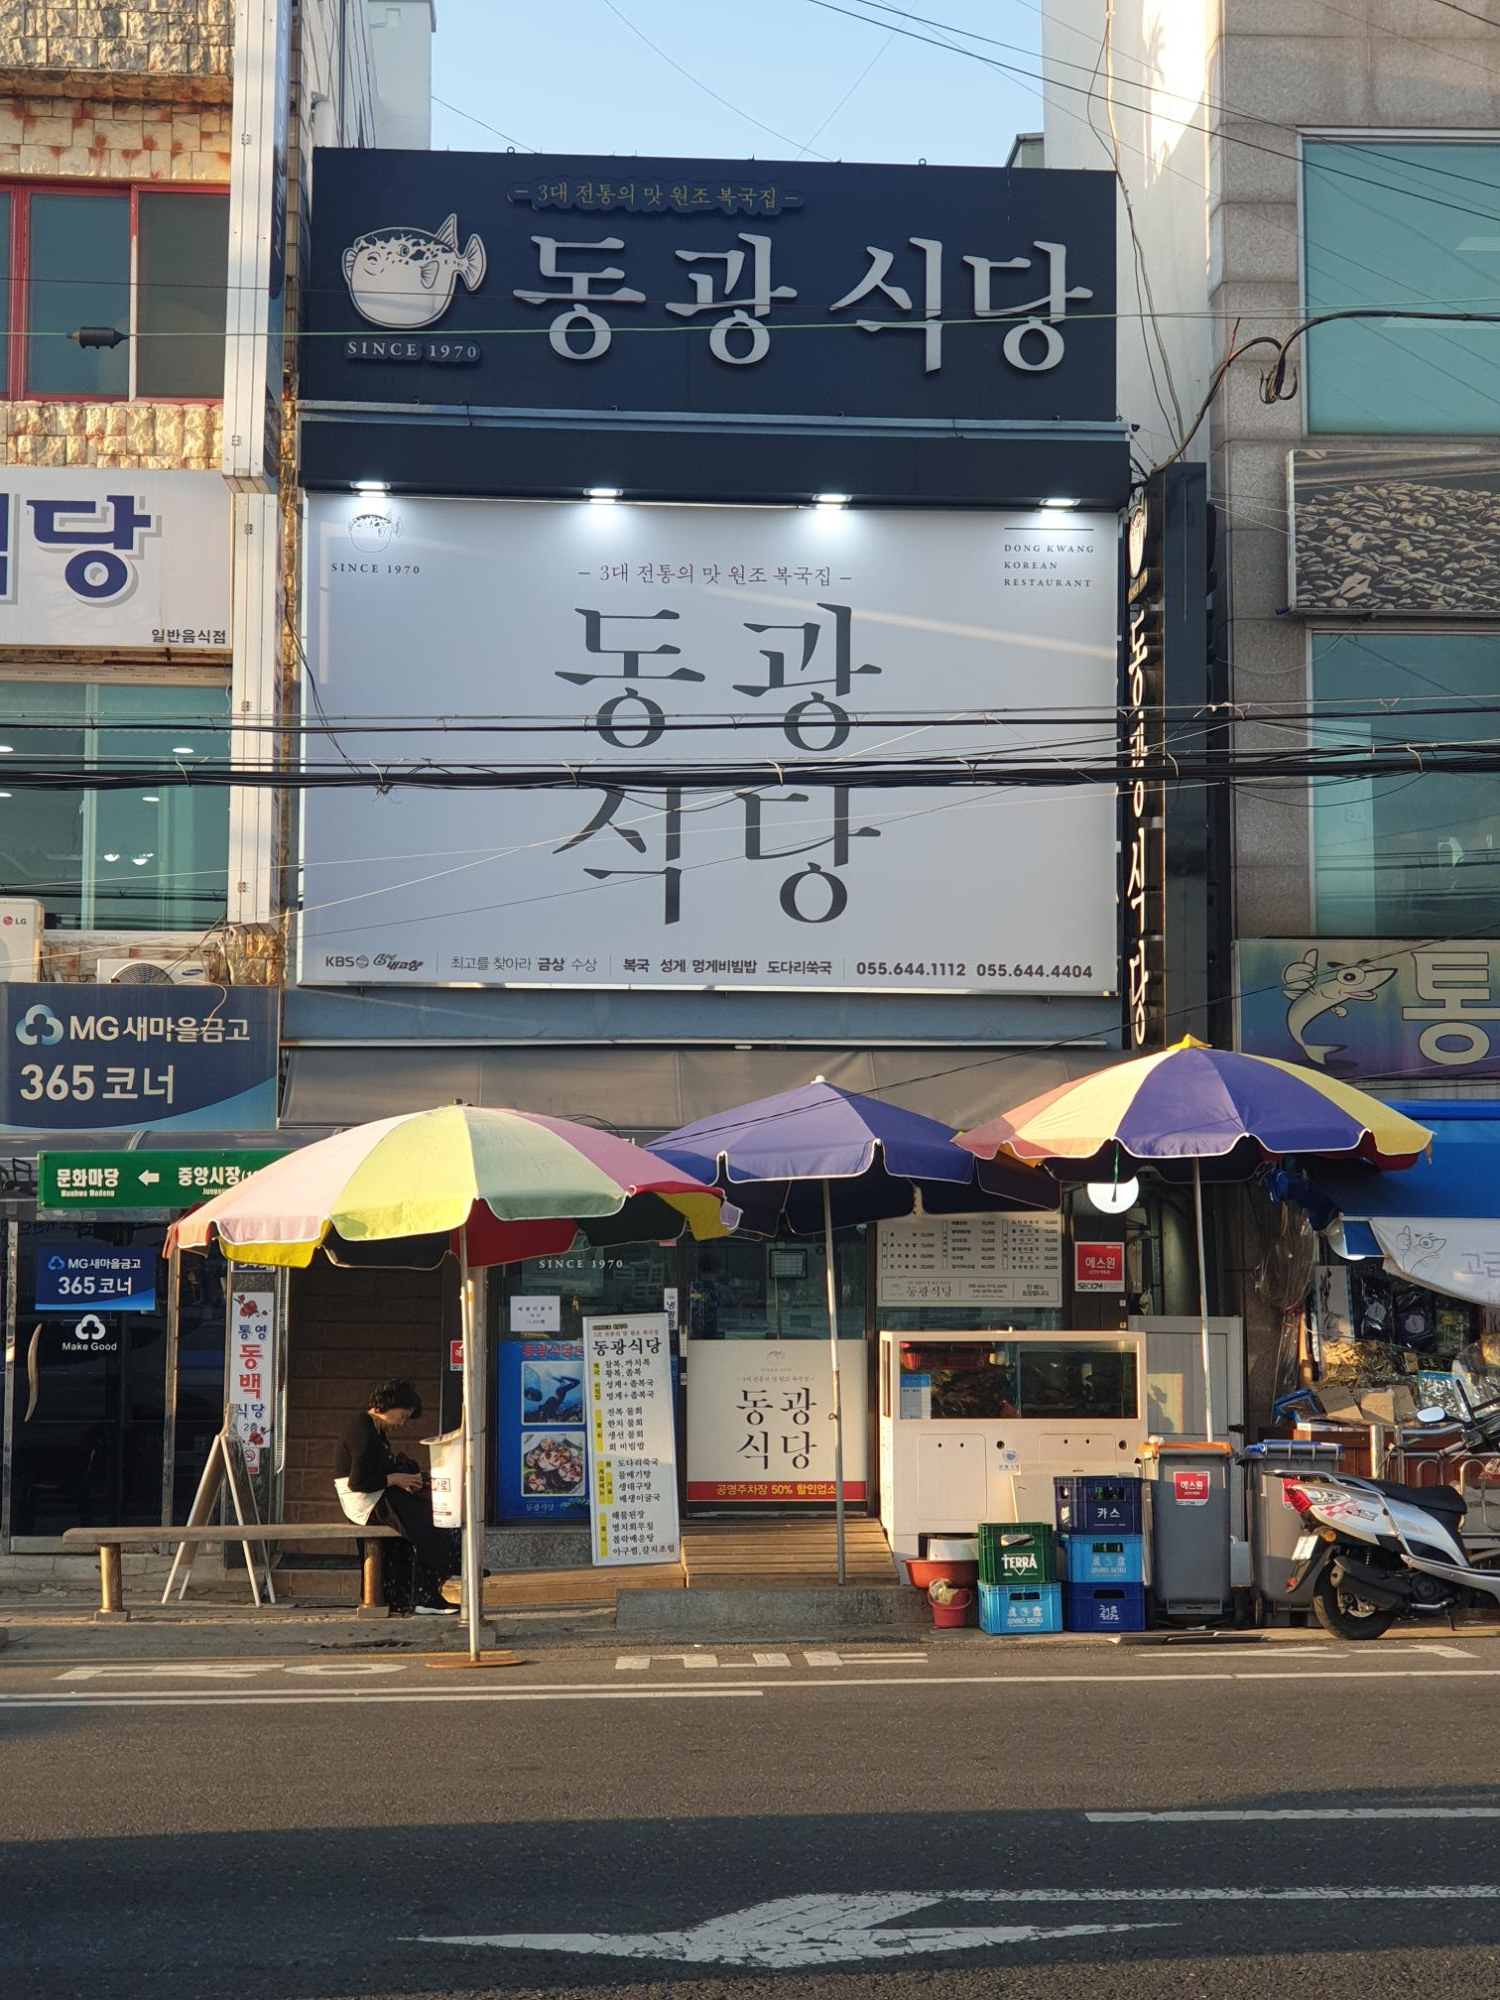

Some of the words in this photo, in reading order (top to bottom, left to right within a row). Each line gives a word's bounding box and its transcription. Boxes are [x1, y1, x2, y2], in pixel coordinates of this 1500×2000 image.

[538, 182, 567, 203] 3대
[576, 183, 635, 205] 전통의
[644, 184, 663, 206] 맛
[670, 185, 711, 207] 원조
[717, 186, 777, 208] 복국집
[348, 341, 417, 356] SINCE
[430, 344, 477, 359] 1970
[0, 493, 151, 598] 당
[1004, 544, 1041, 553] DONG
[1046, 544, 1094, 553] KWANG
[331, 563, 379, 573] SINCE
[387, 564, 420, 574] 1970
[1004, 561, 1058, 569] KOREAN
[600, 562, 628, 584] 3대
[637, 562, 693, 584] 전통의
[702, 564, 721, 585] 맛
[728, 565, 767, 585] 원조
[773, 566, 831, 587] 복국집
[1004, 578, 1092, 587] RESTAURANT
[152, 629, 226, 644] 일반음식점
[554, 602, 882, 752] 동광
[552, 782, 881, 925] 식당
[326, 956, 354, 967] KBS
[451, 957, 489, 970] 최고를
[493, 957, 531, 971] 찾아라
[538, 957, 565, 971] 금상
[571, 958, 597, 972] 수상
[623, 958, 650, 973] 복국
[767, 961, 832, 975] 도다리쑥국
[857, 962, 966, 977] 055.644.1112
[976, 963, 1092, 979] 055.644.4404
[20, 1064, 95, 1101] 365
[102, 1065, 174, 1104] 코너
[57, 1168, 119, 1188] 문화마당
[539, 1260, 584, 1269] SINCE
[592, 1260, 624, 1269] 1970
[1085, 1257, 1116, 1269] 에스원
[58, 1277, 95, 1295] 365
[98, 1277, 132, 1295] 코너
[238, 1324, 267, 1340] 통영
[91, 1342, 117, 1350] Good
[592, 1337, 662, 1357] 동광식당
[239, 1344, 262, 1399] 동백
[237, 1404, 265, 1419] 식당
[736, 1387, 817, 1425] 동광
[736, 1431, 818, 1470] 식당
[716, 1484, 767, 1495] 공영주차장
[771, 1485, 793, 1494] 50%
[1097, 1507, 1121, 1519] 카스
[1002, 1553, 1037, 1569] TERRA
